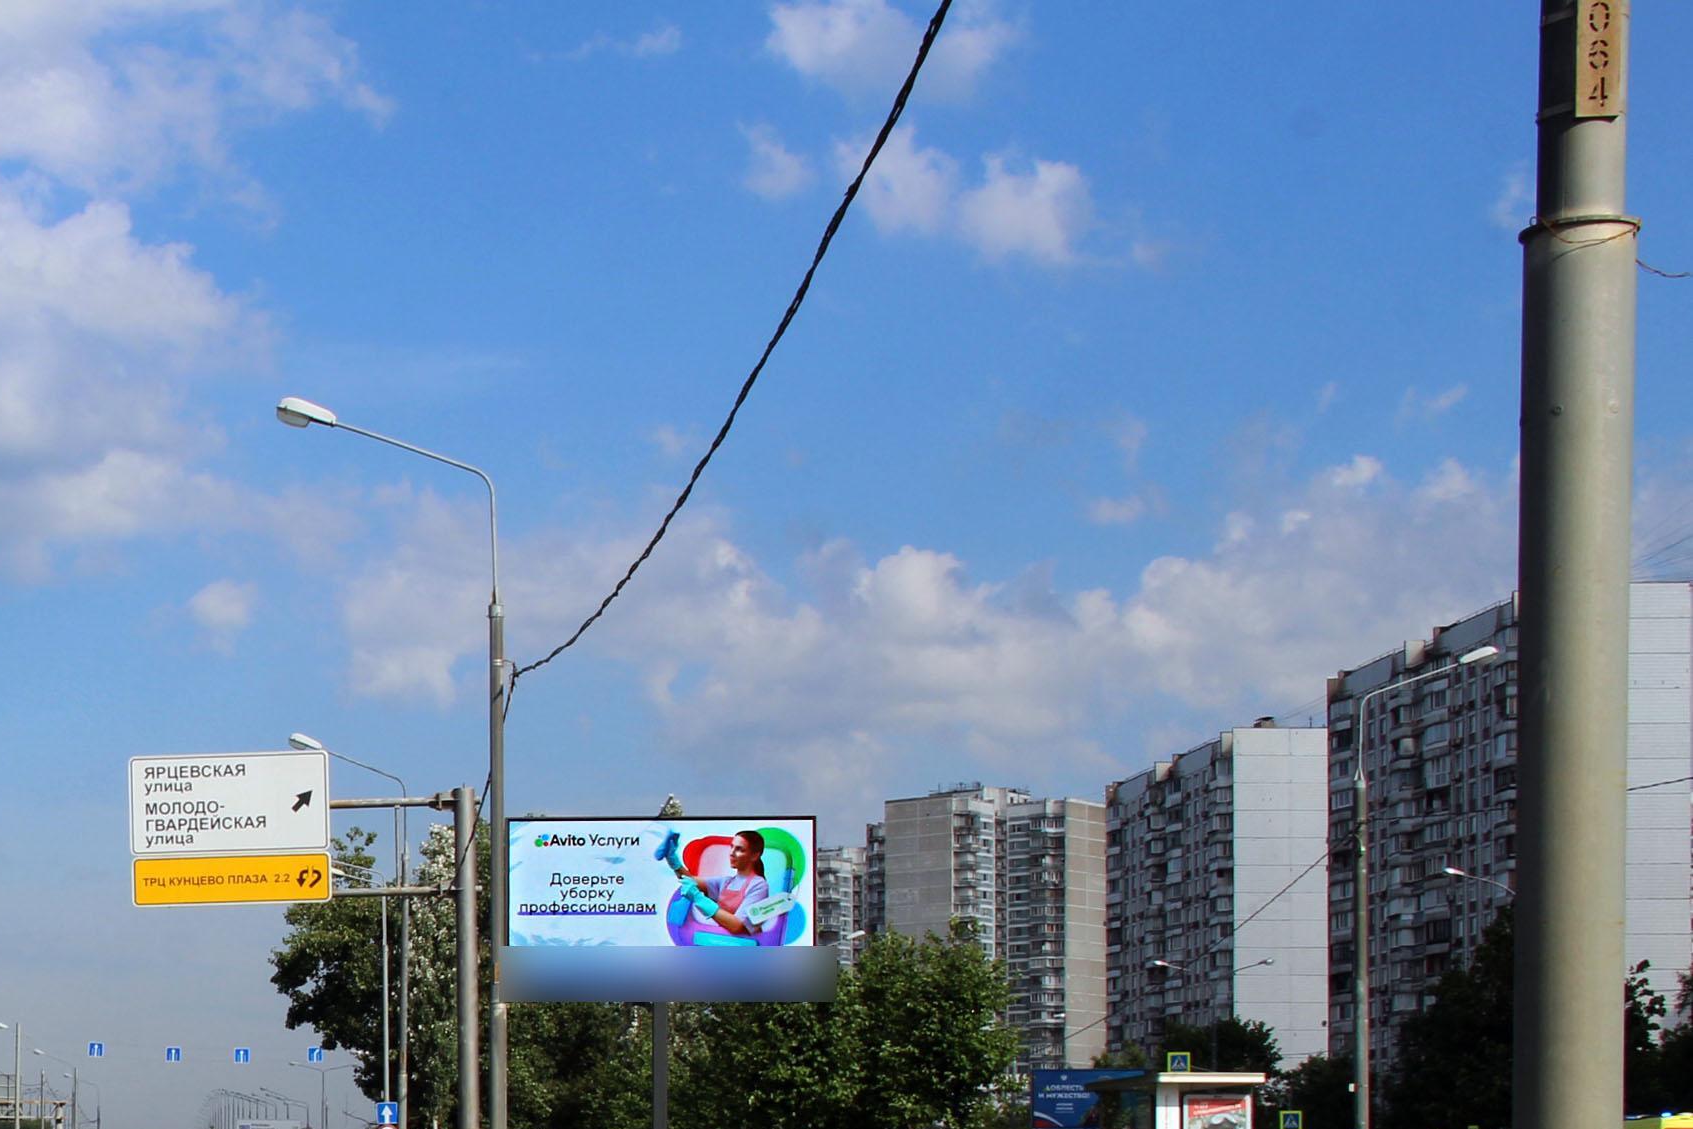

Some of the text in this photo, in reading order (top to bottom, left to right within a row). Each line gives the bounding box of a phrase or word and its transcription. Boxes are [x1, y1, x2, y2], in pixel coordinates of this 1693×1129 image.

[144, 763, 246, 780] ЯРЦЕВСКАЯ
[144, 781, 193, 796] улица
[145, 800, 226, 816] МОЛОДО-
[146, 814, 267, 833] ГВАРДЕЙСКАЯ
[146, 834, 194, 848] улица
[550, 834, 640, 849] Avito Услуги
[143, 873, 290, 888] ТРЦ КУНЦЕВО ПЛАЗА 2.2
[549, 872, 624, 887] Доверьте
[560, 886, 614, 901] уборку
[519, 901, 656, 915] профессионалам
